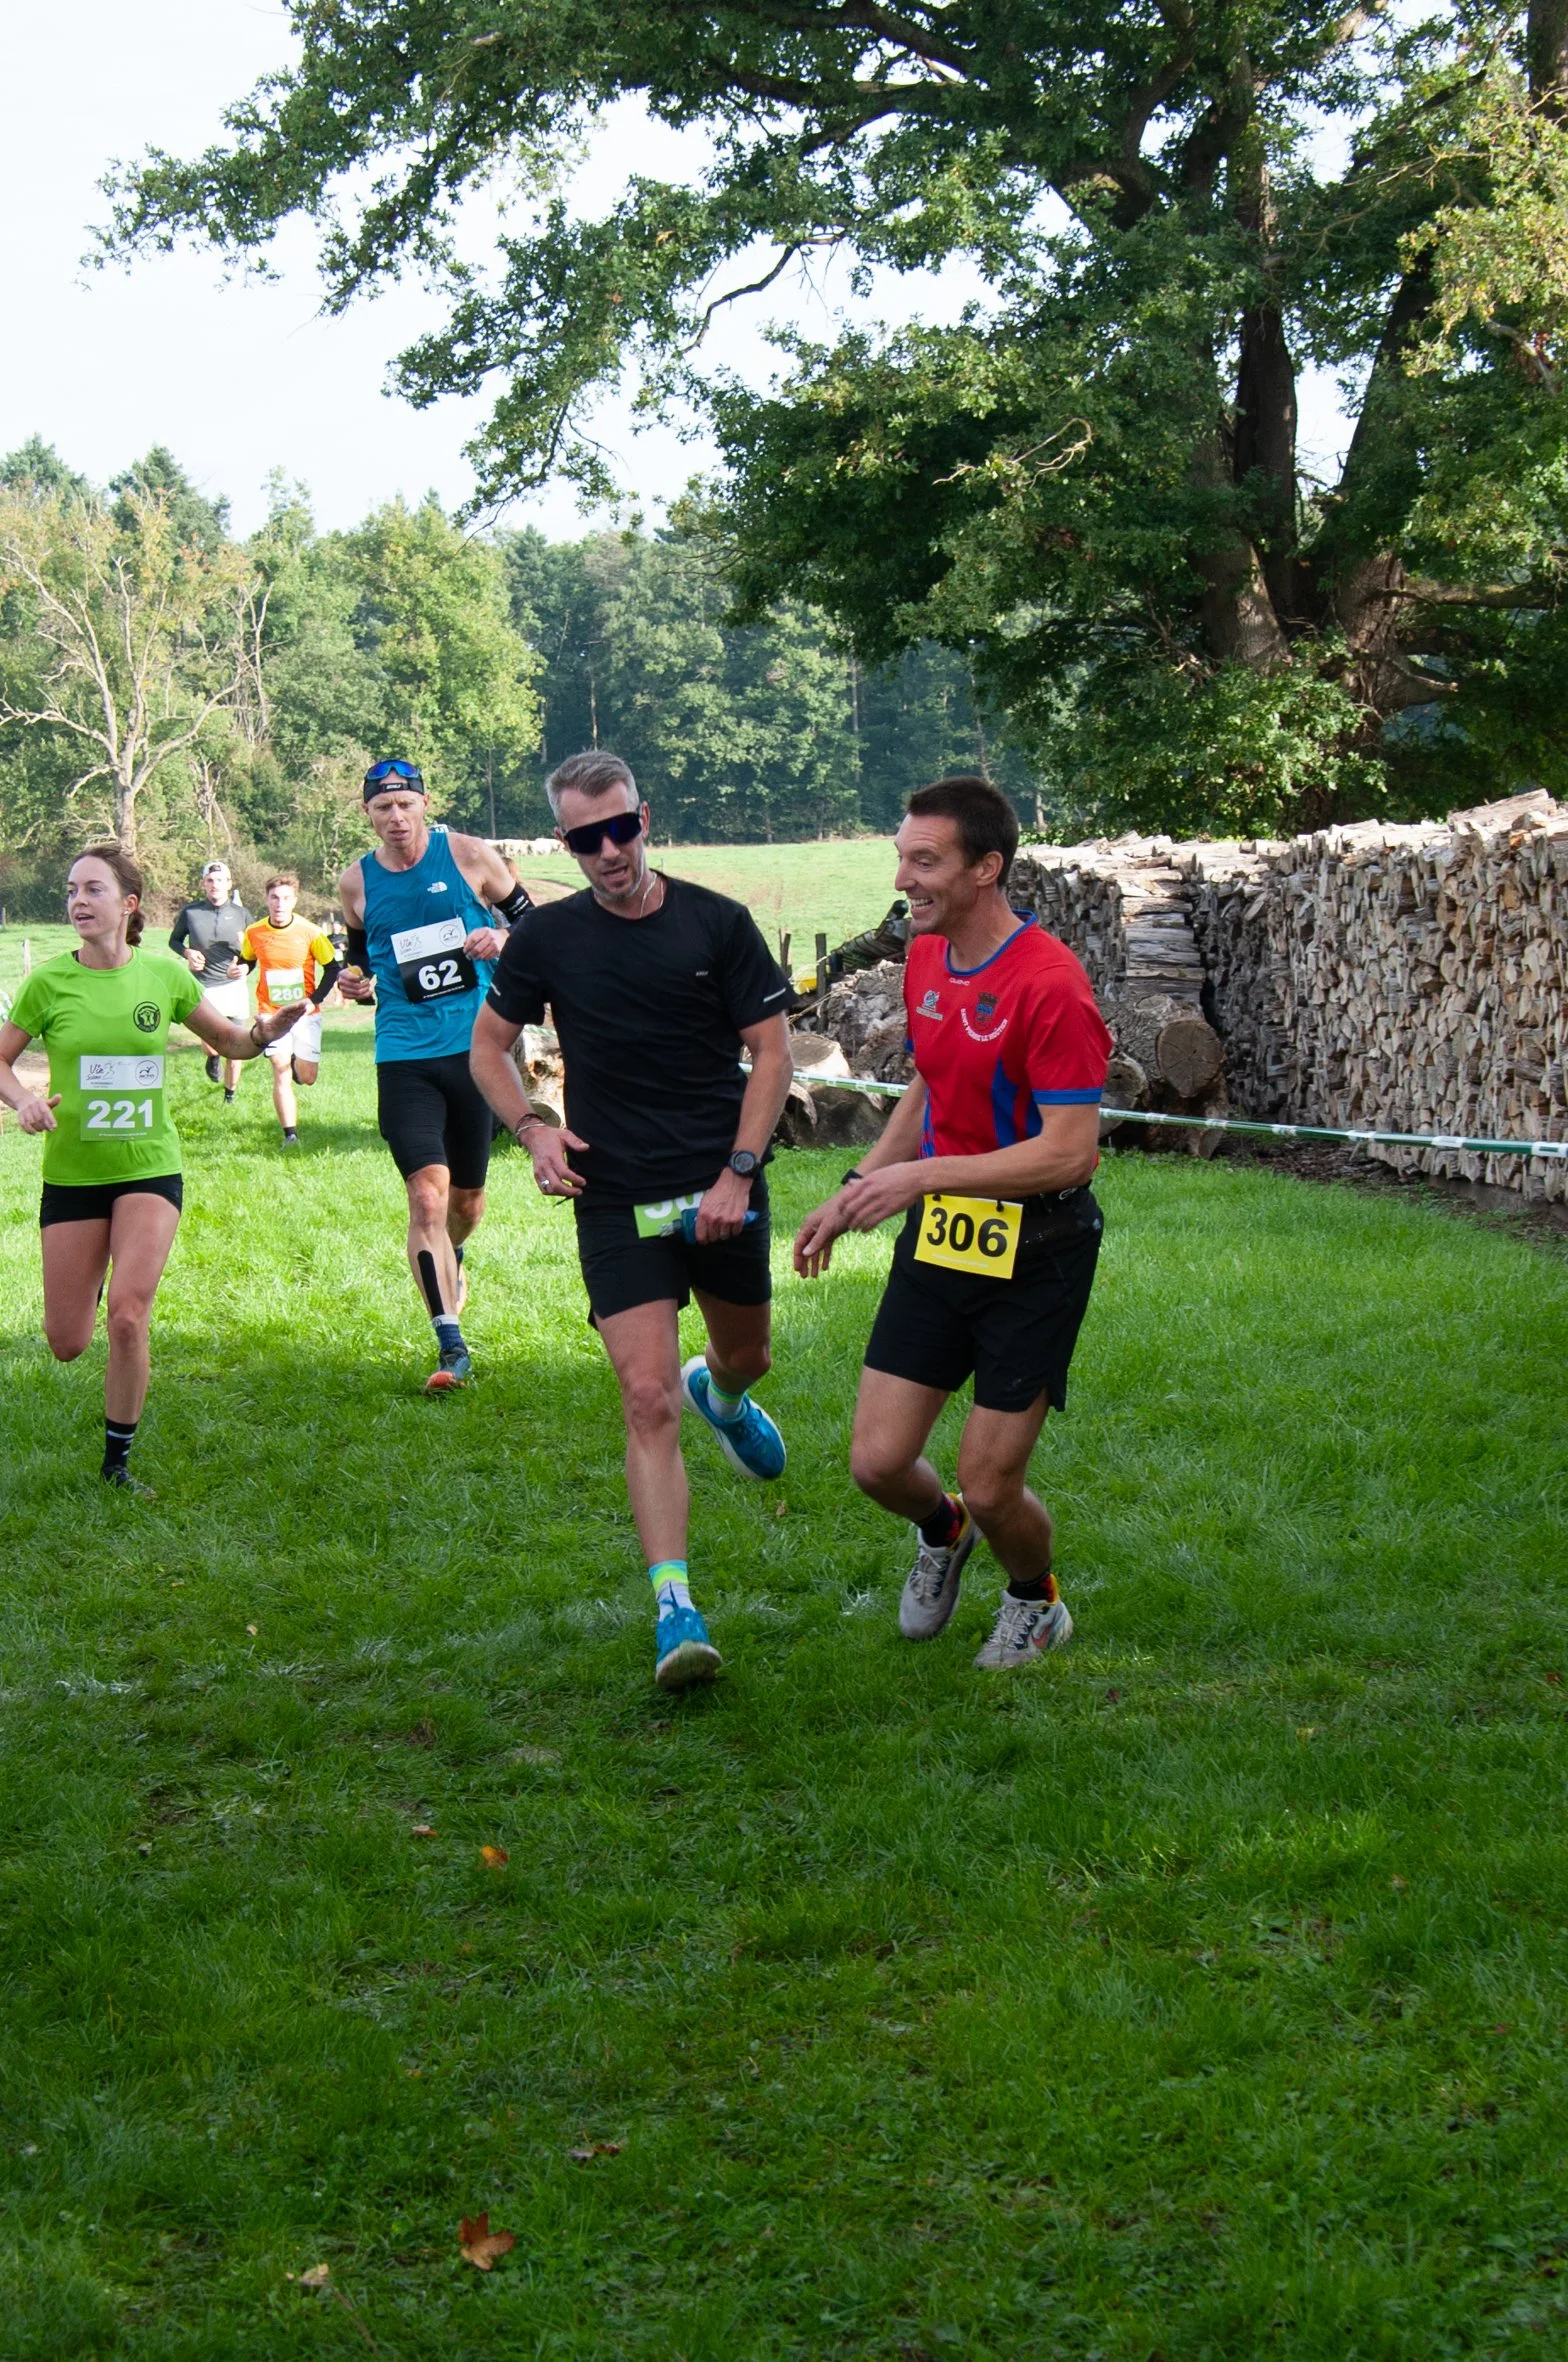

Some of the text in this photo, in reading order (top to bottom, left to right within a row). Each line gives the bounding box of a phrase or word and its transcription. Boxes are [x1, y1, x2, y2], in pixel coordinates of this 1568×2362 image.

[418, 959, 463, 991] 62
[271, 987, 303, 1001] 280
[86, 1099, 153, 1128] 221
[926, 1206, 1009, 1258] 306
